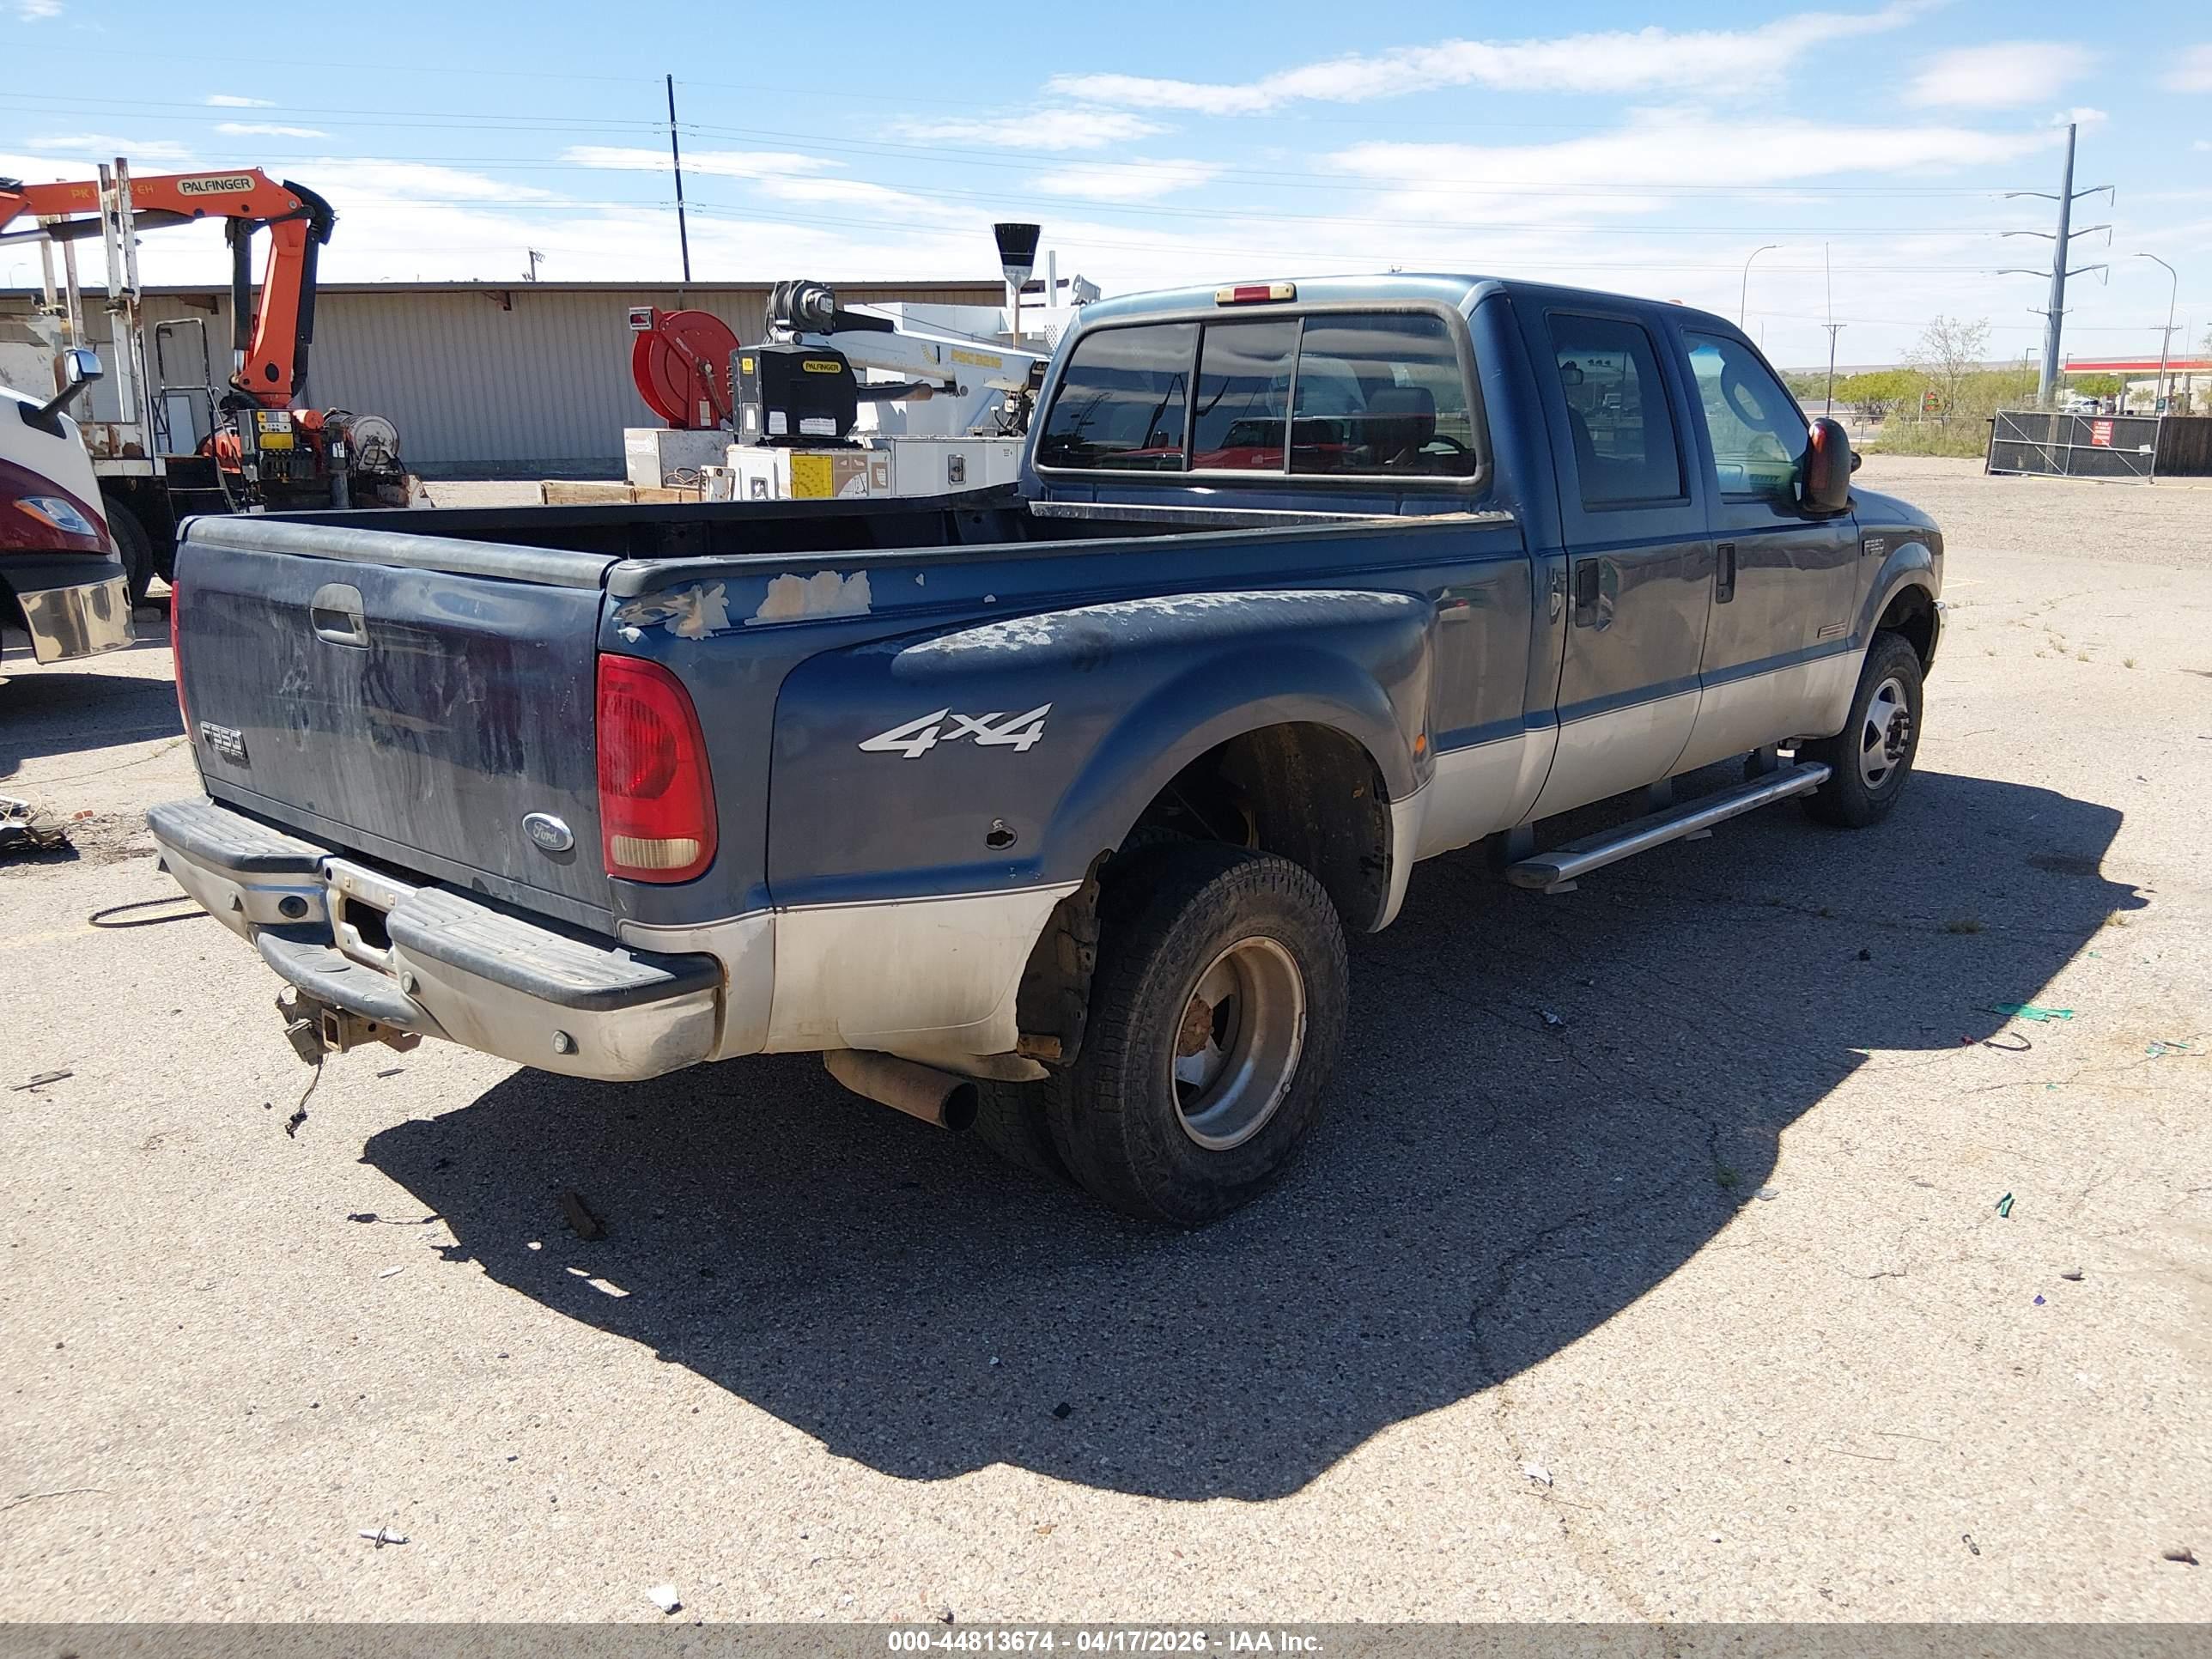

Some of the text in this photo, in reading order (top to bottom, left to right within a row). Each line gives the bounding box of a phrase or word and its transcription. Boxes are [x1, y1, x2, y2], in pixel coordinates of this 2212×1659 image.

[181, 177, 252, 193] PALFINGER
[805, 362, 839, 372] PALFINGER
[532, 821, 558, 843] Ford
